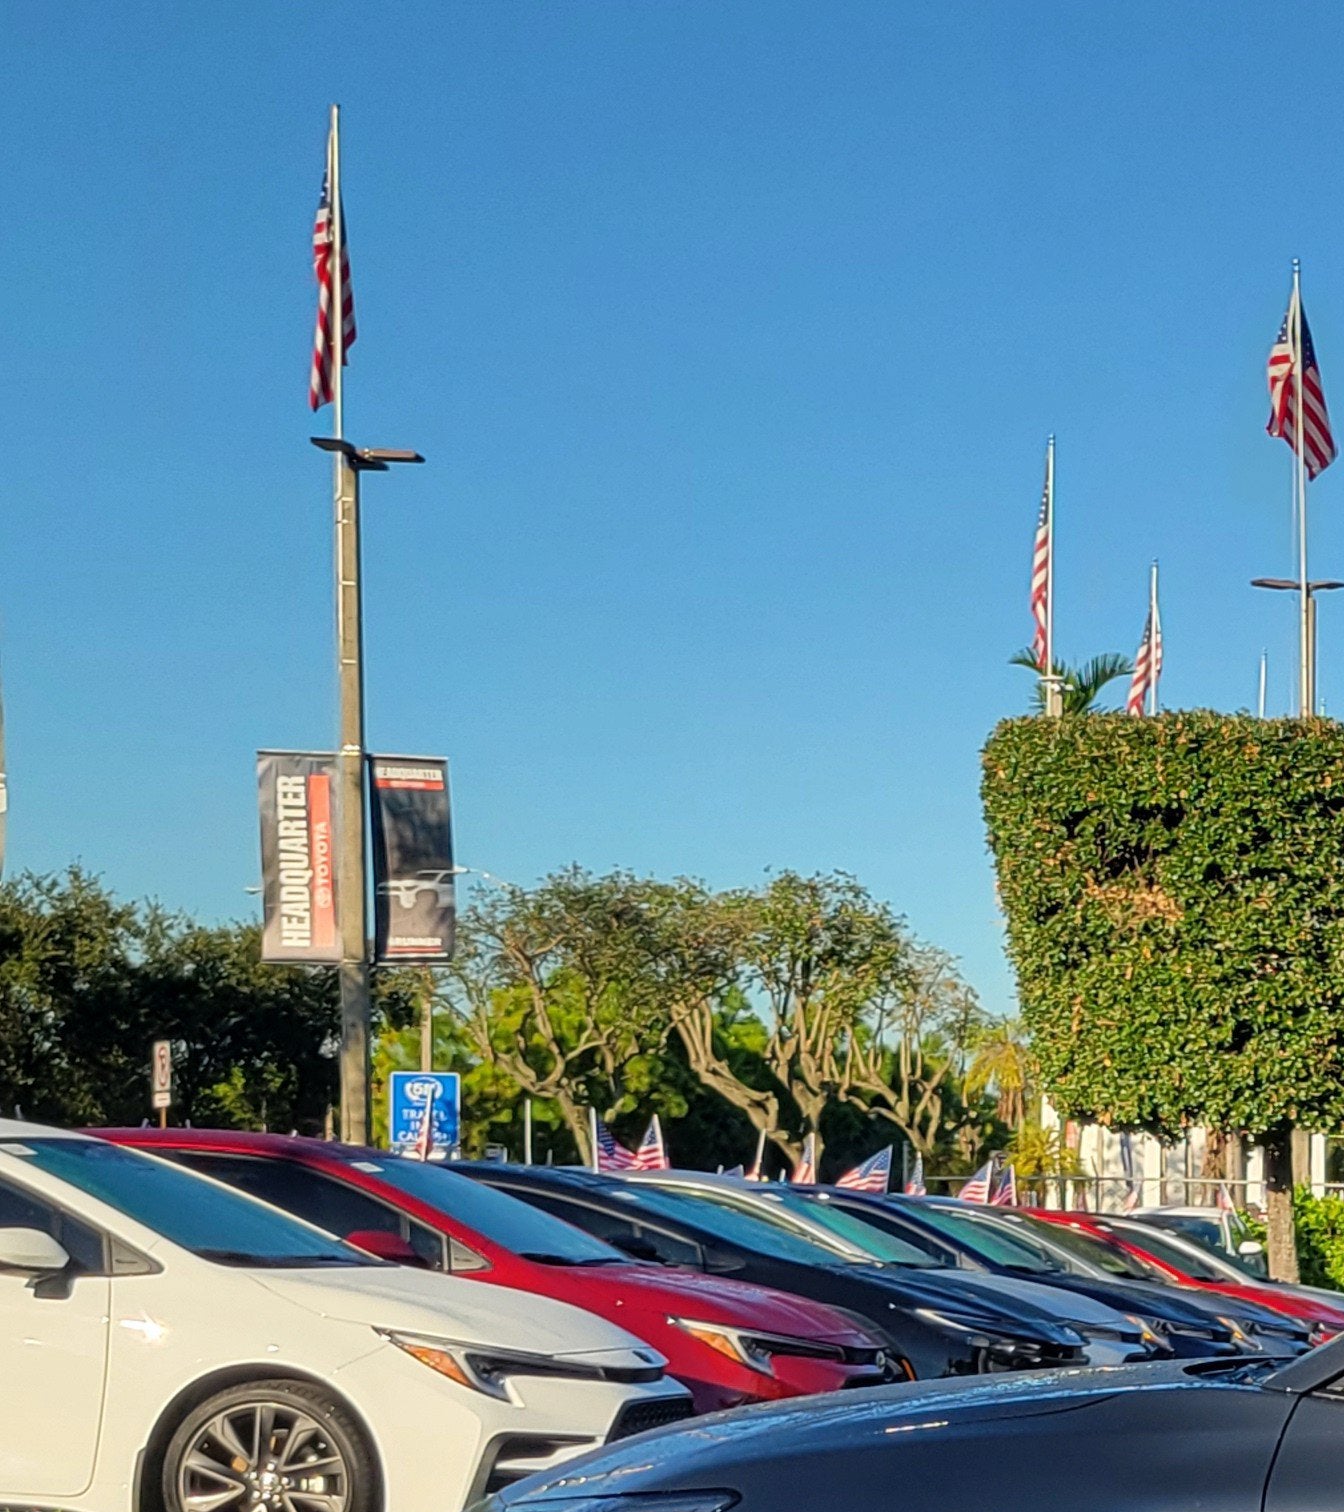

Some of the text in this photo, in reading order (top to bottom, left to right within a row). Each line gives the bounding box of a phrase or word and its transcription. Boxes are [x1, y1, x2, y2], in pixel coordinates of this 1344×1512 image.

[276, 776, 313, 947] HEADQUARTER
[315, 821, 330, 885] TOYOTA
[402, 1109, 448, 1121] TRAEL
